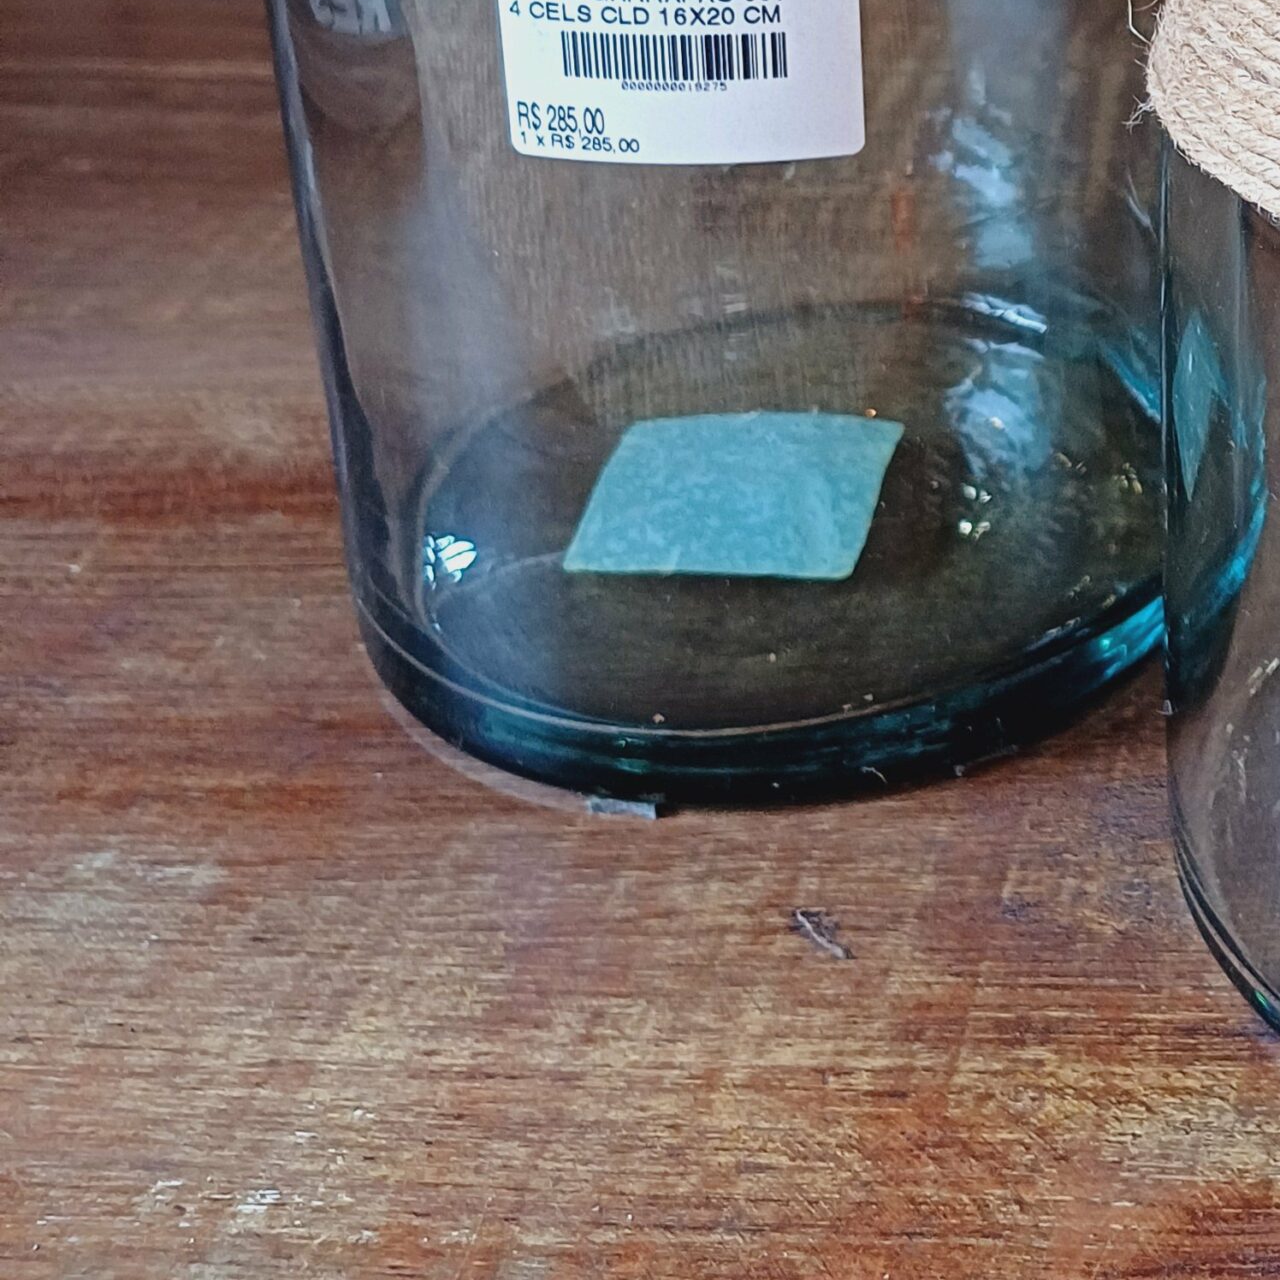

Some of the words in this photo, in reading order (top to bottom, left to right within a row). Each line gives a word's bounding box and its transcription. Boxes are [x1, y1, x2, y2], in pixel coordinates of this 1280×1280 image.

[509, 0, 521, 17] 4
[529, 1, 592, 23] CELS
[600, 6, 650, 26] CLD
[659, 6, 735, 27] 16X20
[743, 4, 782, 24] CM
[517, 101, 542, 131] R$
[546, 104, 605, 137] 285,00
[520, 131, 527, 144] 1
[537, 136, 545, 147] x
[551, 135, 574, 150] R$
[581, 136, 640, 154] 285,00
